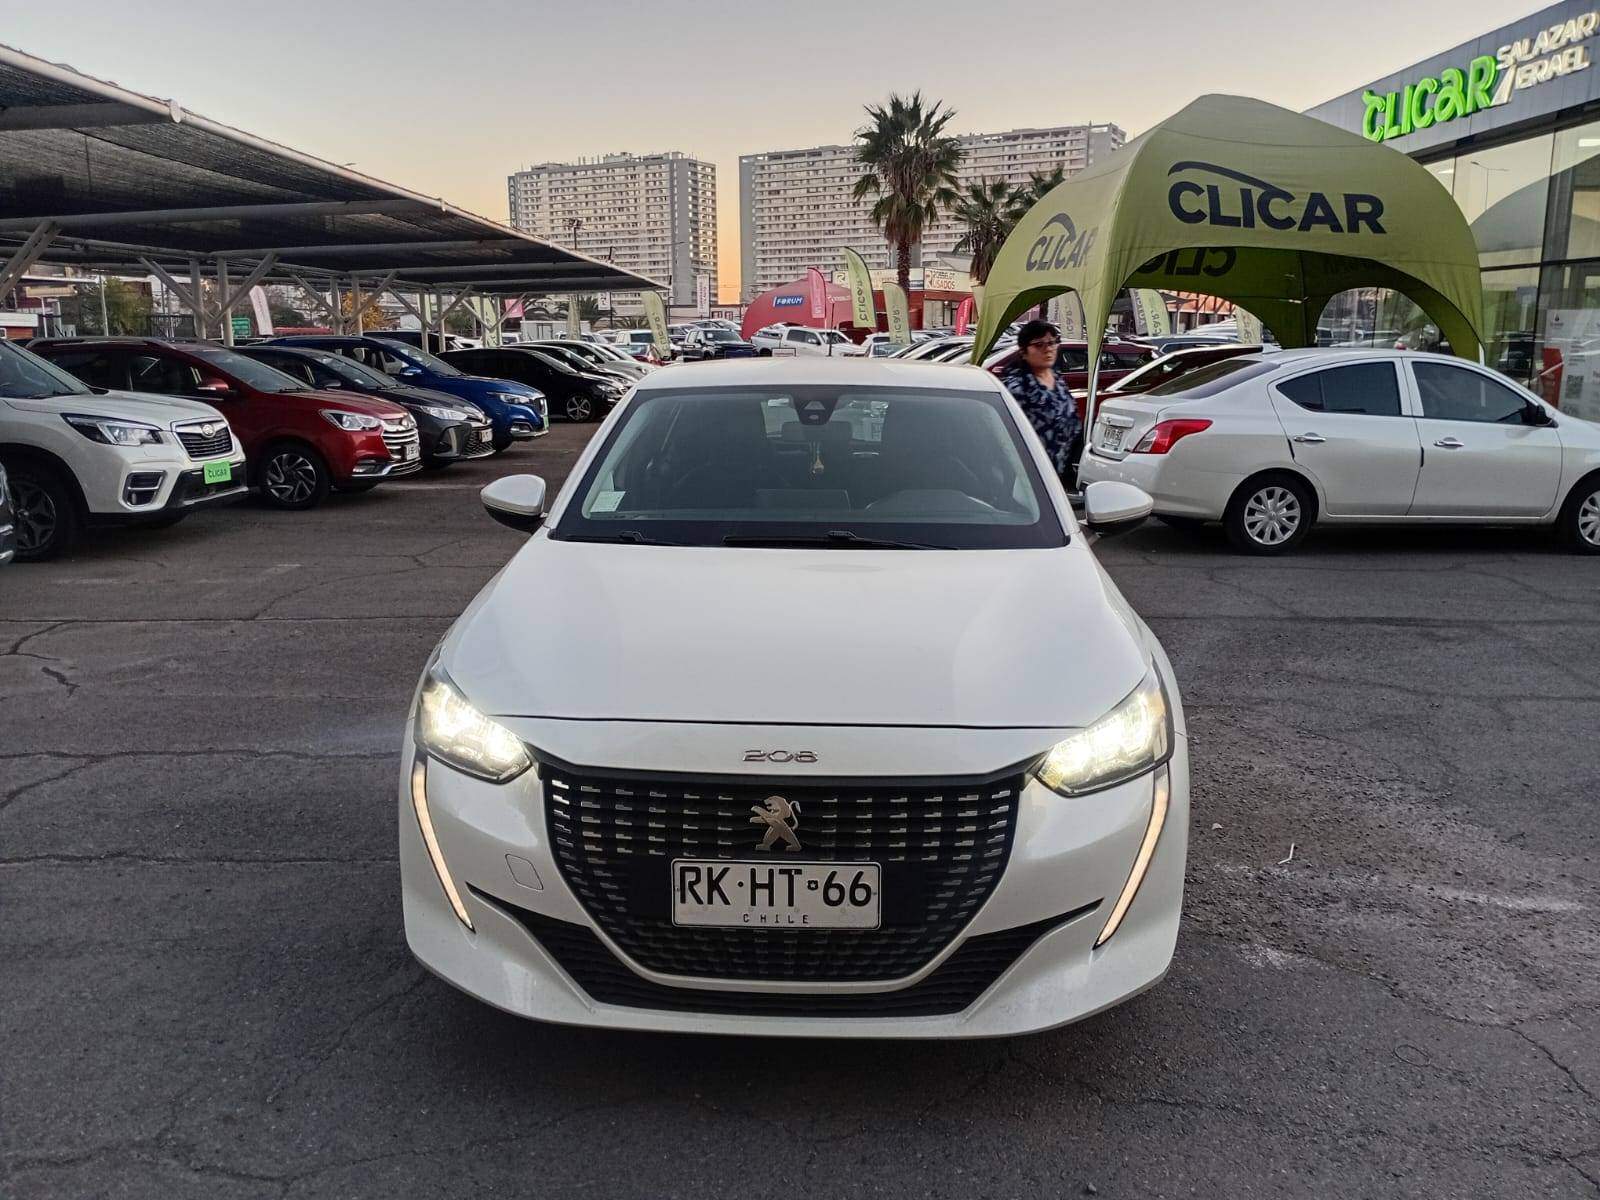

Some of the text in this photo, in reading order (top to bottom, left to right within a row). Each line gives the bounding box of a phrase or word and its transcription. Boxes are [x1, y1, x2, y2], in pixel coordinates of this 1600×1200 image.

[1496, 12, 1600, 70] SALAZAR
[1168, 181, 1387, 234] CLICAR
[1026, 225, 1098, 272] CLICAR
[742, 750, 819, 763] 208
[743, 913, 809, 924] CHILE
